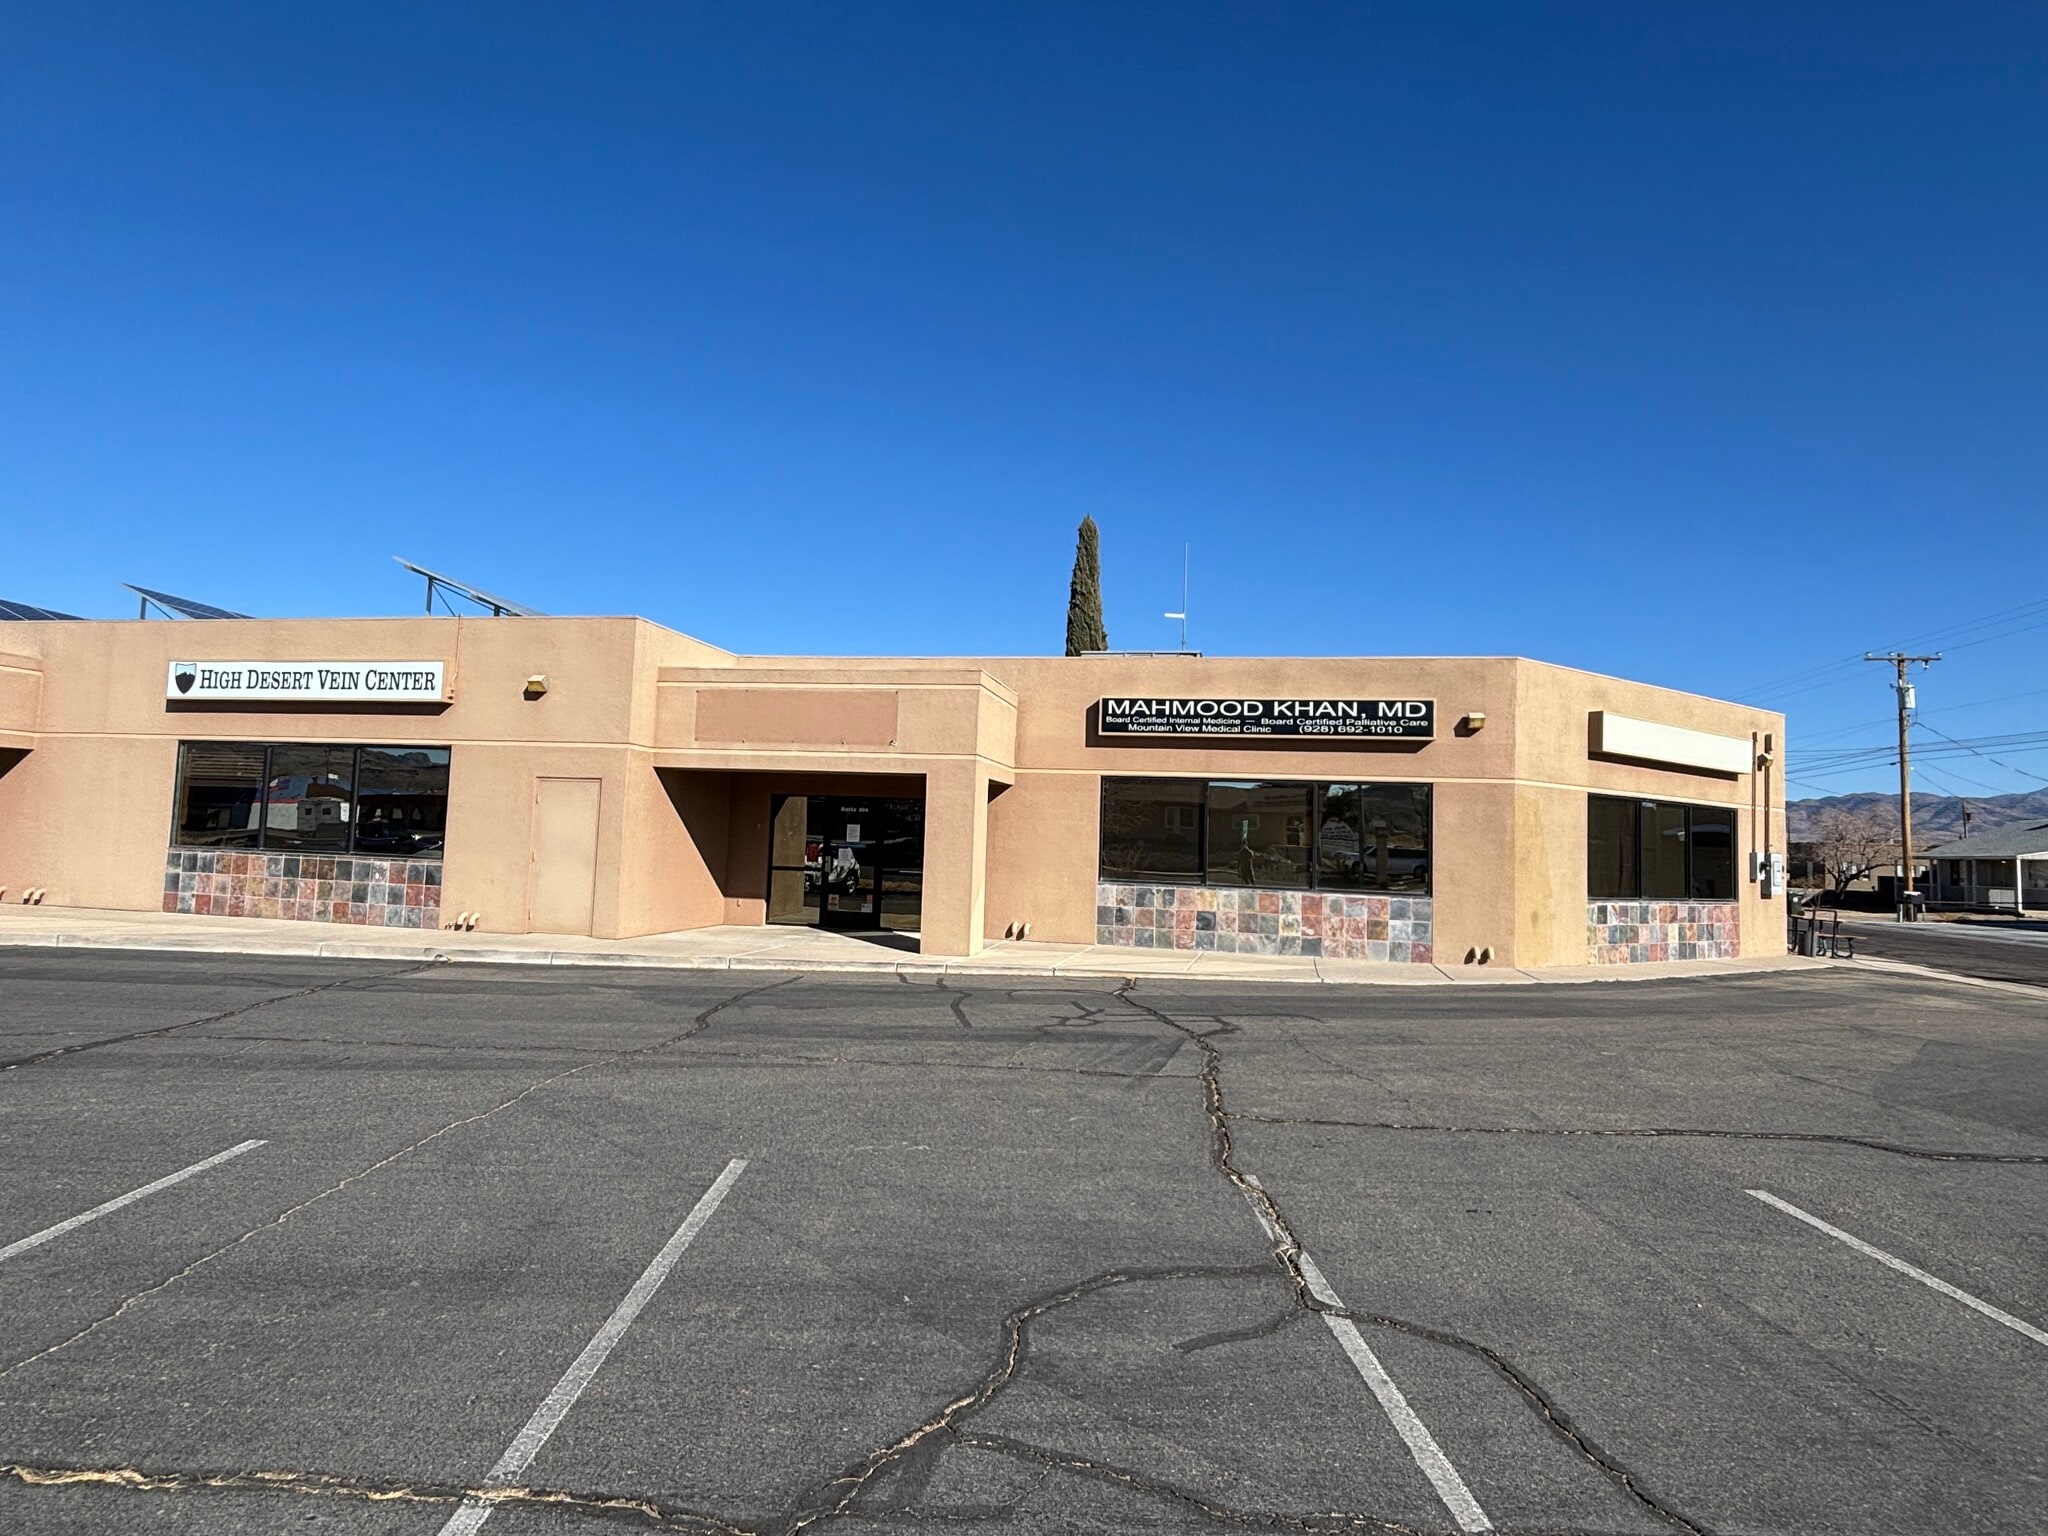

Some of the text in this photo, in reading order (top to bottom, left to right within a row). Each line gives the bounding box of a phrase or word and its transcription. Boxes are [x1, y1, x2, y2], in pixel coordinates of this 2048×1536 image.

[199, 669, 436, 691] HIGH DESERT VEIN CENTER
[1108, 700, 1427, 719] MAHMOOD KHAN, MD
[1128, 724, 1173, 732] Mountain
[1175, 724, 1199, 732] View
[1202, 725, 1241, 733] Medical
[1299, 725, 1334, 734] (928)
[1337, 726, 1404, 734] 692-1010
[1133, 716, 1167, 724] Certified
[1203, 717, 1241, 725] Medicine
[1296, 718, 1343, 726] Certified
[1346, 718, 1397, 727] Palliative
[1400, 719, 1429, 727] Care
